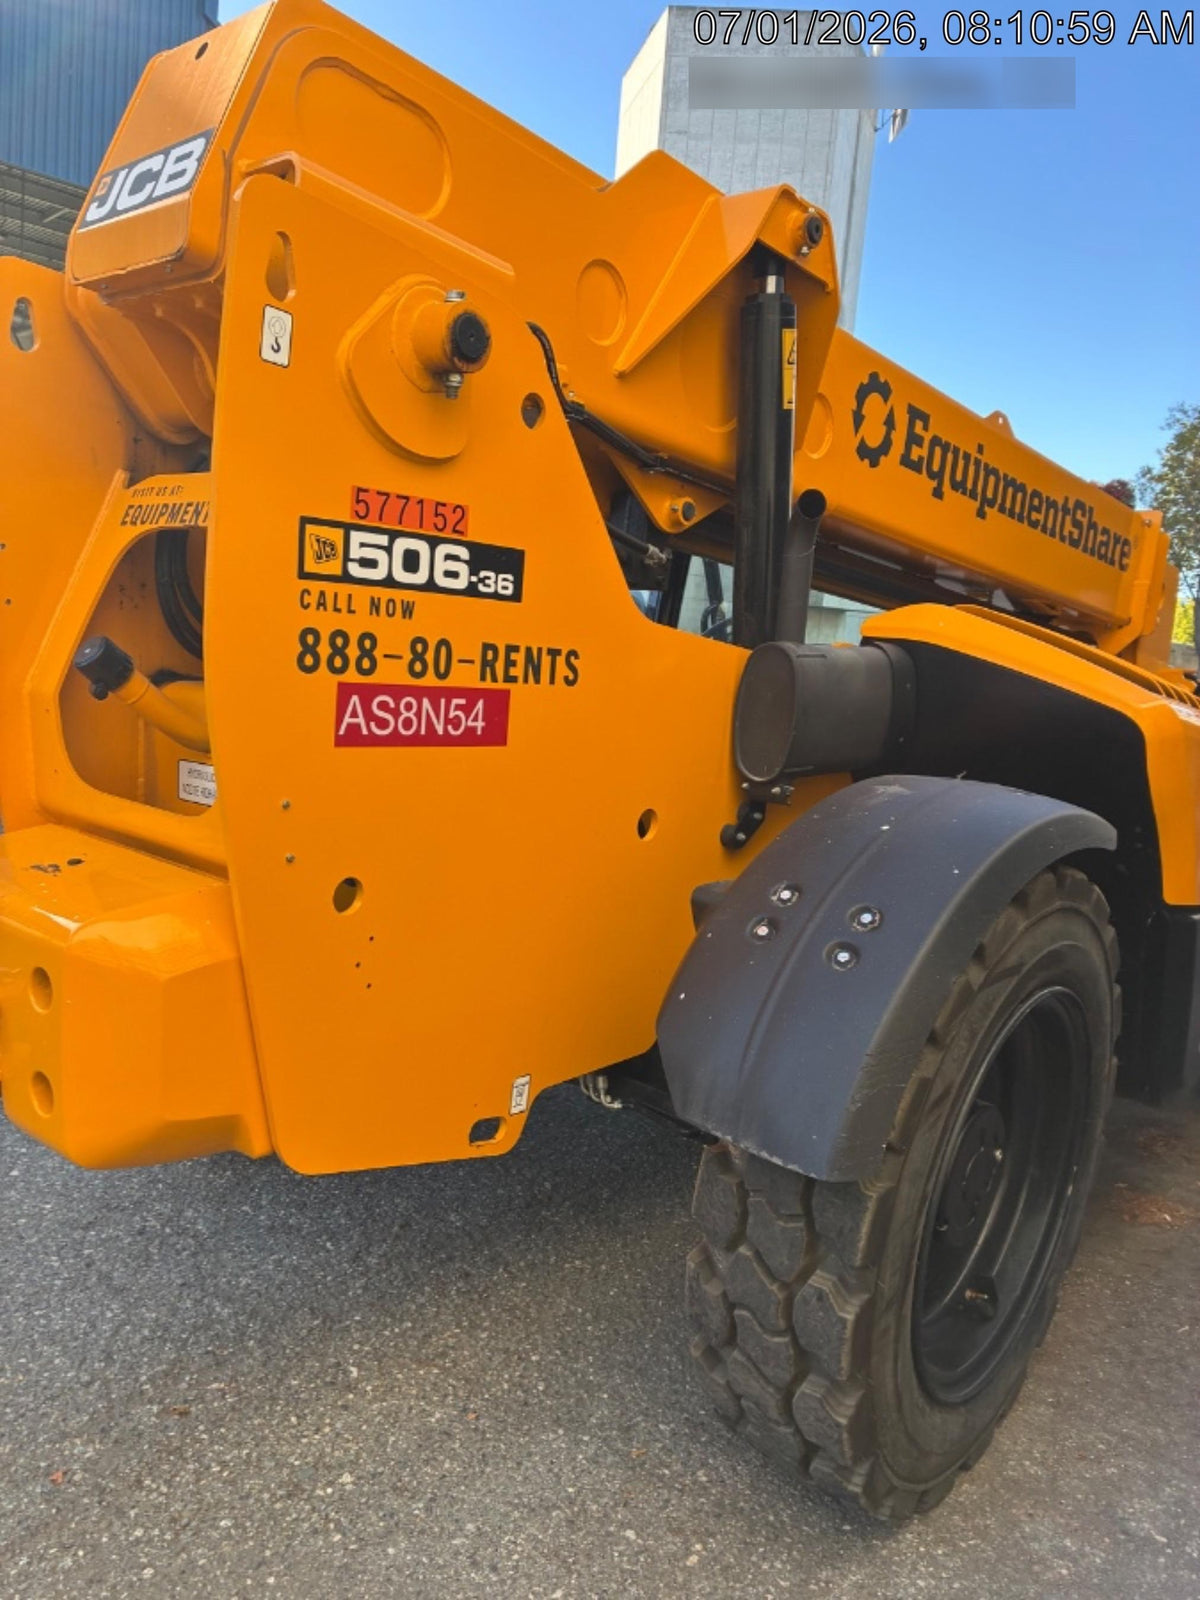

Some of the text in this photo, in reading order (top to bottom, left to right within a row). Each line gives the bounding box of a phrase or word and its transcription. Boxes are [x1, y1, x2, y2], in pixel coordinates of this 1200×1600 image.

[86, 137, 207, 222] JCB
[353, 486, 467, 535] 577152
[899, 402, 1132, 572] EquipmentShare
[299, 588, 416, 620] CALL NOW
[296, 626, 580, 687] 888-80-RENTS
[337, 694, 485, 736] AS8N54
